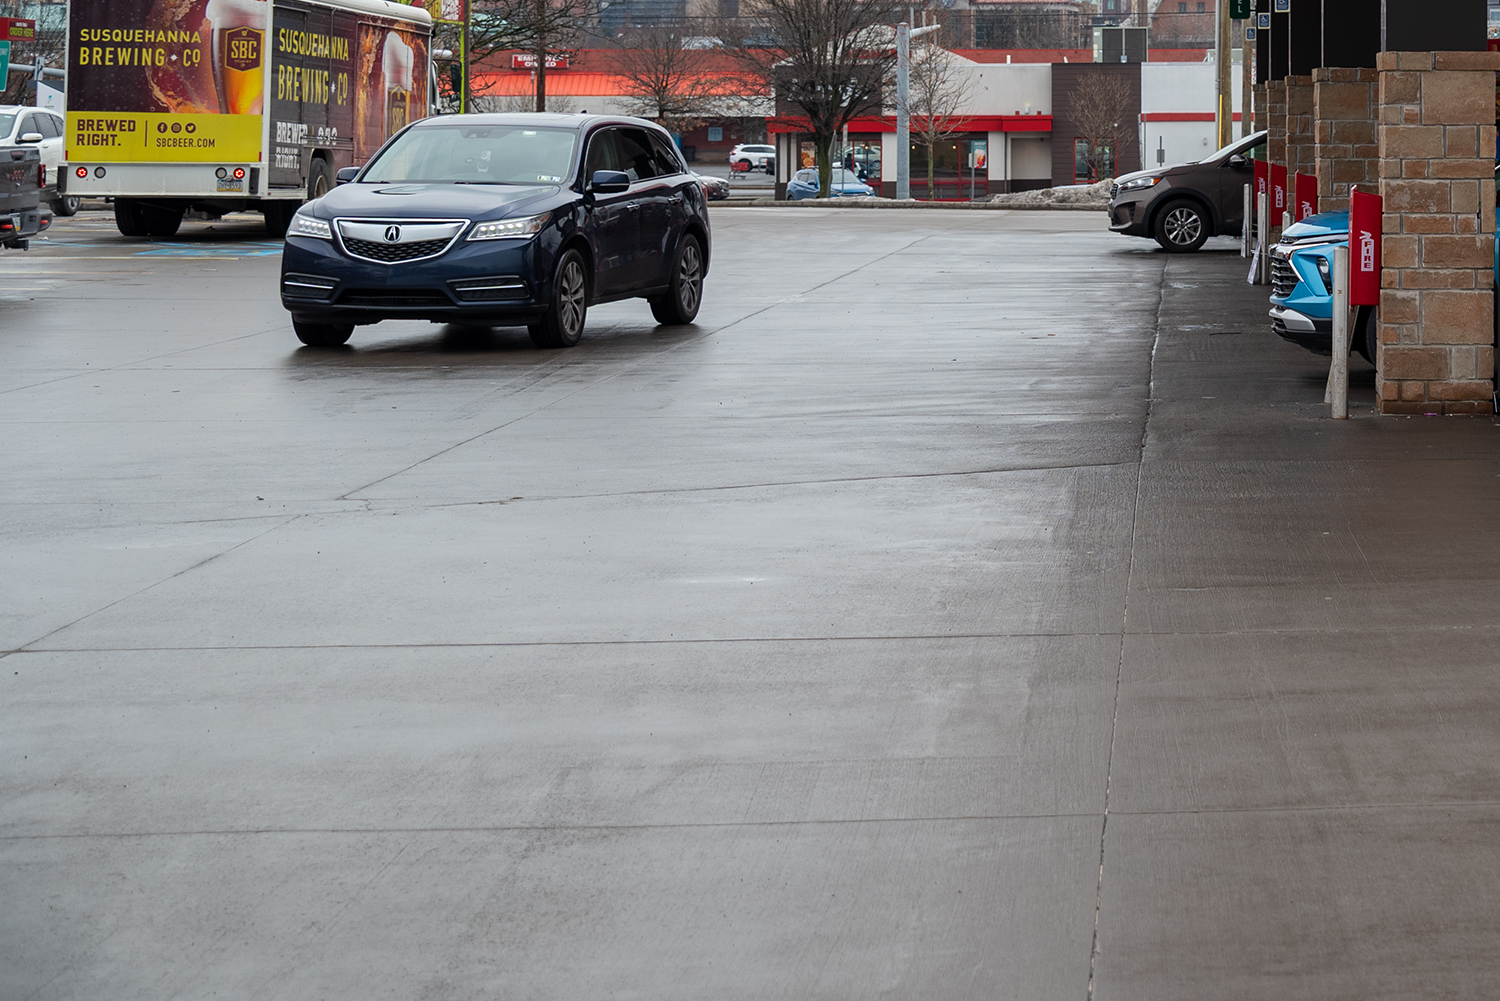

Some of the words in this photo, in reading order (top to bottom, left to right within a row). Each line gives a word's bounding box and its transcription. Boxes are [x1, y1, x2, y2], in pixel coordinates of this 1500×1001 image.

[80, 28, 201, 44] SUSQUEHANNA
[279, 28, 349, 61] SUSQUEHANNA
[79, 47, 165, 67] BREWING
[231, 41, 257, 59] SBC
[278, 64, 329, 105] BREWING
[77, 119, 136, 133] BREWED
[77, 134, 122, 147] RIGHT.
[156, 138, 215, 148] SBCBEER.COM
[1364, 241, 1372, 269] FIRE
